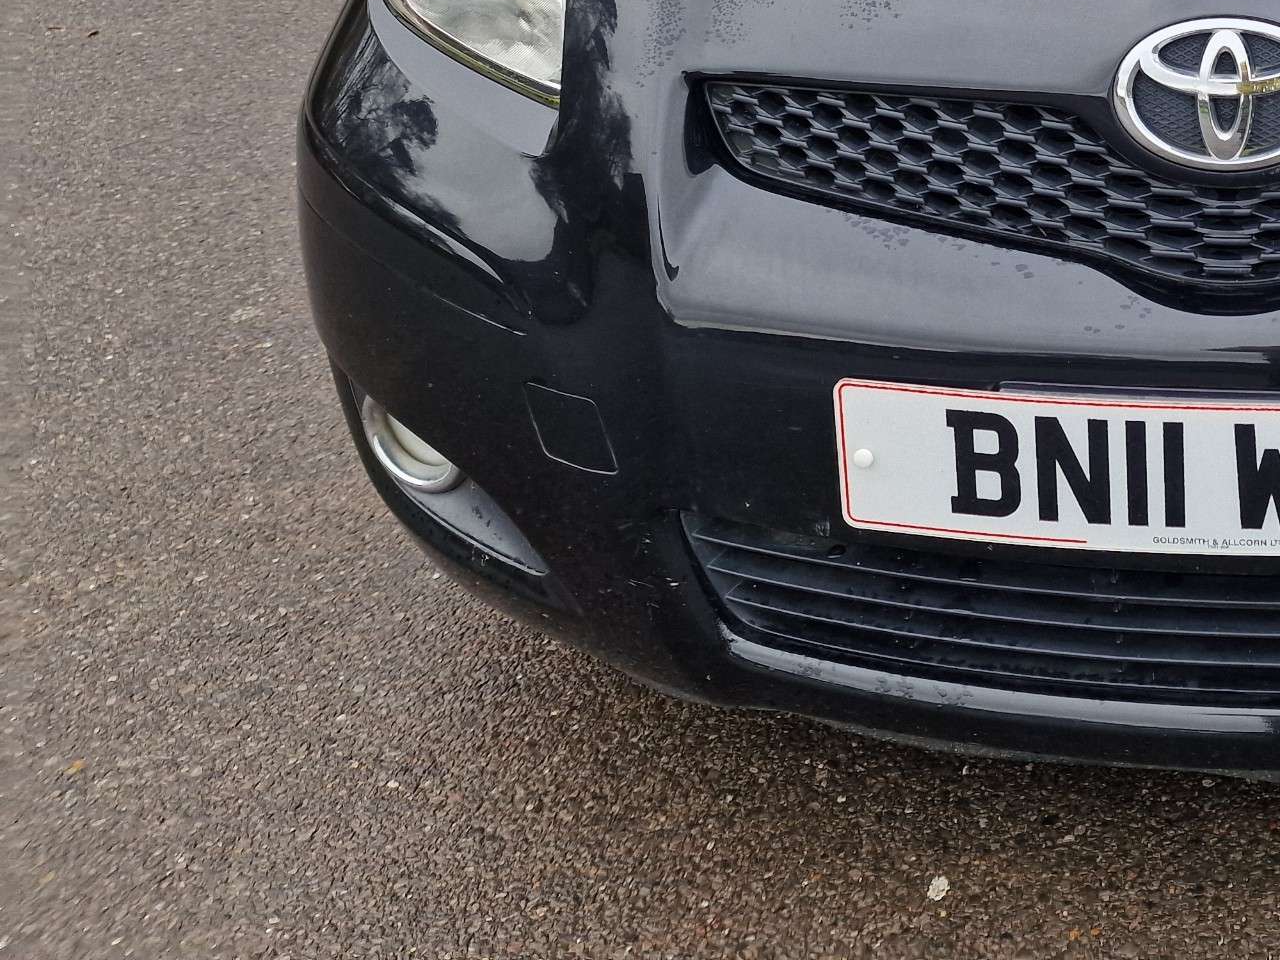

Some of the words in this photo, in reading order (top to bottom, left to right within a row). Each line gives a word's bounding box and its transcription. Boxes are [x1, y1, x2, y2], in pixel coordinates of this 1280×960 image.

[946, 408, 1186, 527] BN11
[1152, 536, 1209, 546] GOLDSMITH
[1212, 538, 1219, 546] &
[1221, 538, 1267, 548] ALLCORN
